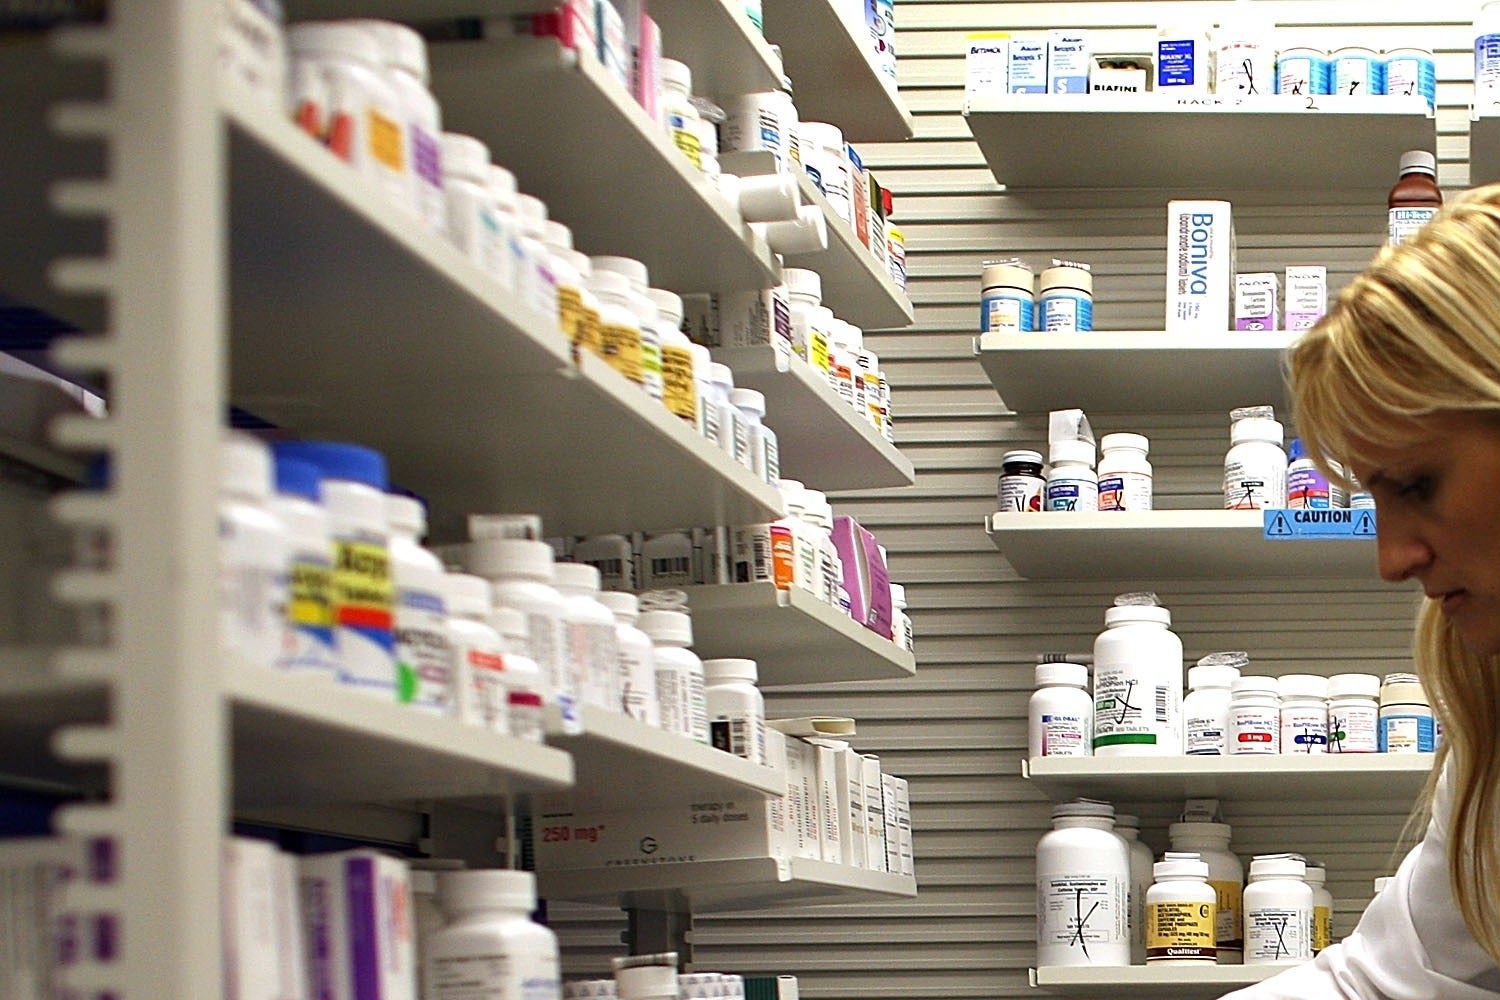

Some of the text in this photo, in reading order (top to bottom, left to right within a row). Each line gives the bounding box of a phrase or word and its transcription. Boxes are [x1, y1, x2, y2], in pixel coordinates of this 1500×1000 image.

[1094, 84, 1138, 92] BIAFINE
[1191, 213, 1213, 295] Boniva
[1294, 511, 1352, 523] CAUTION
[1167, 948, 1200, 956] Qualitest
